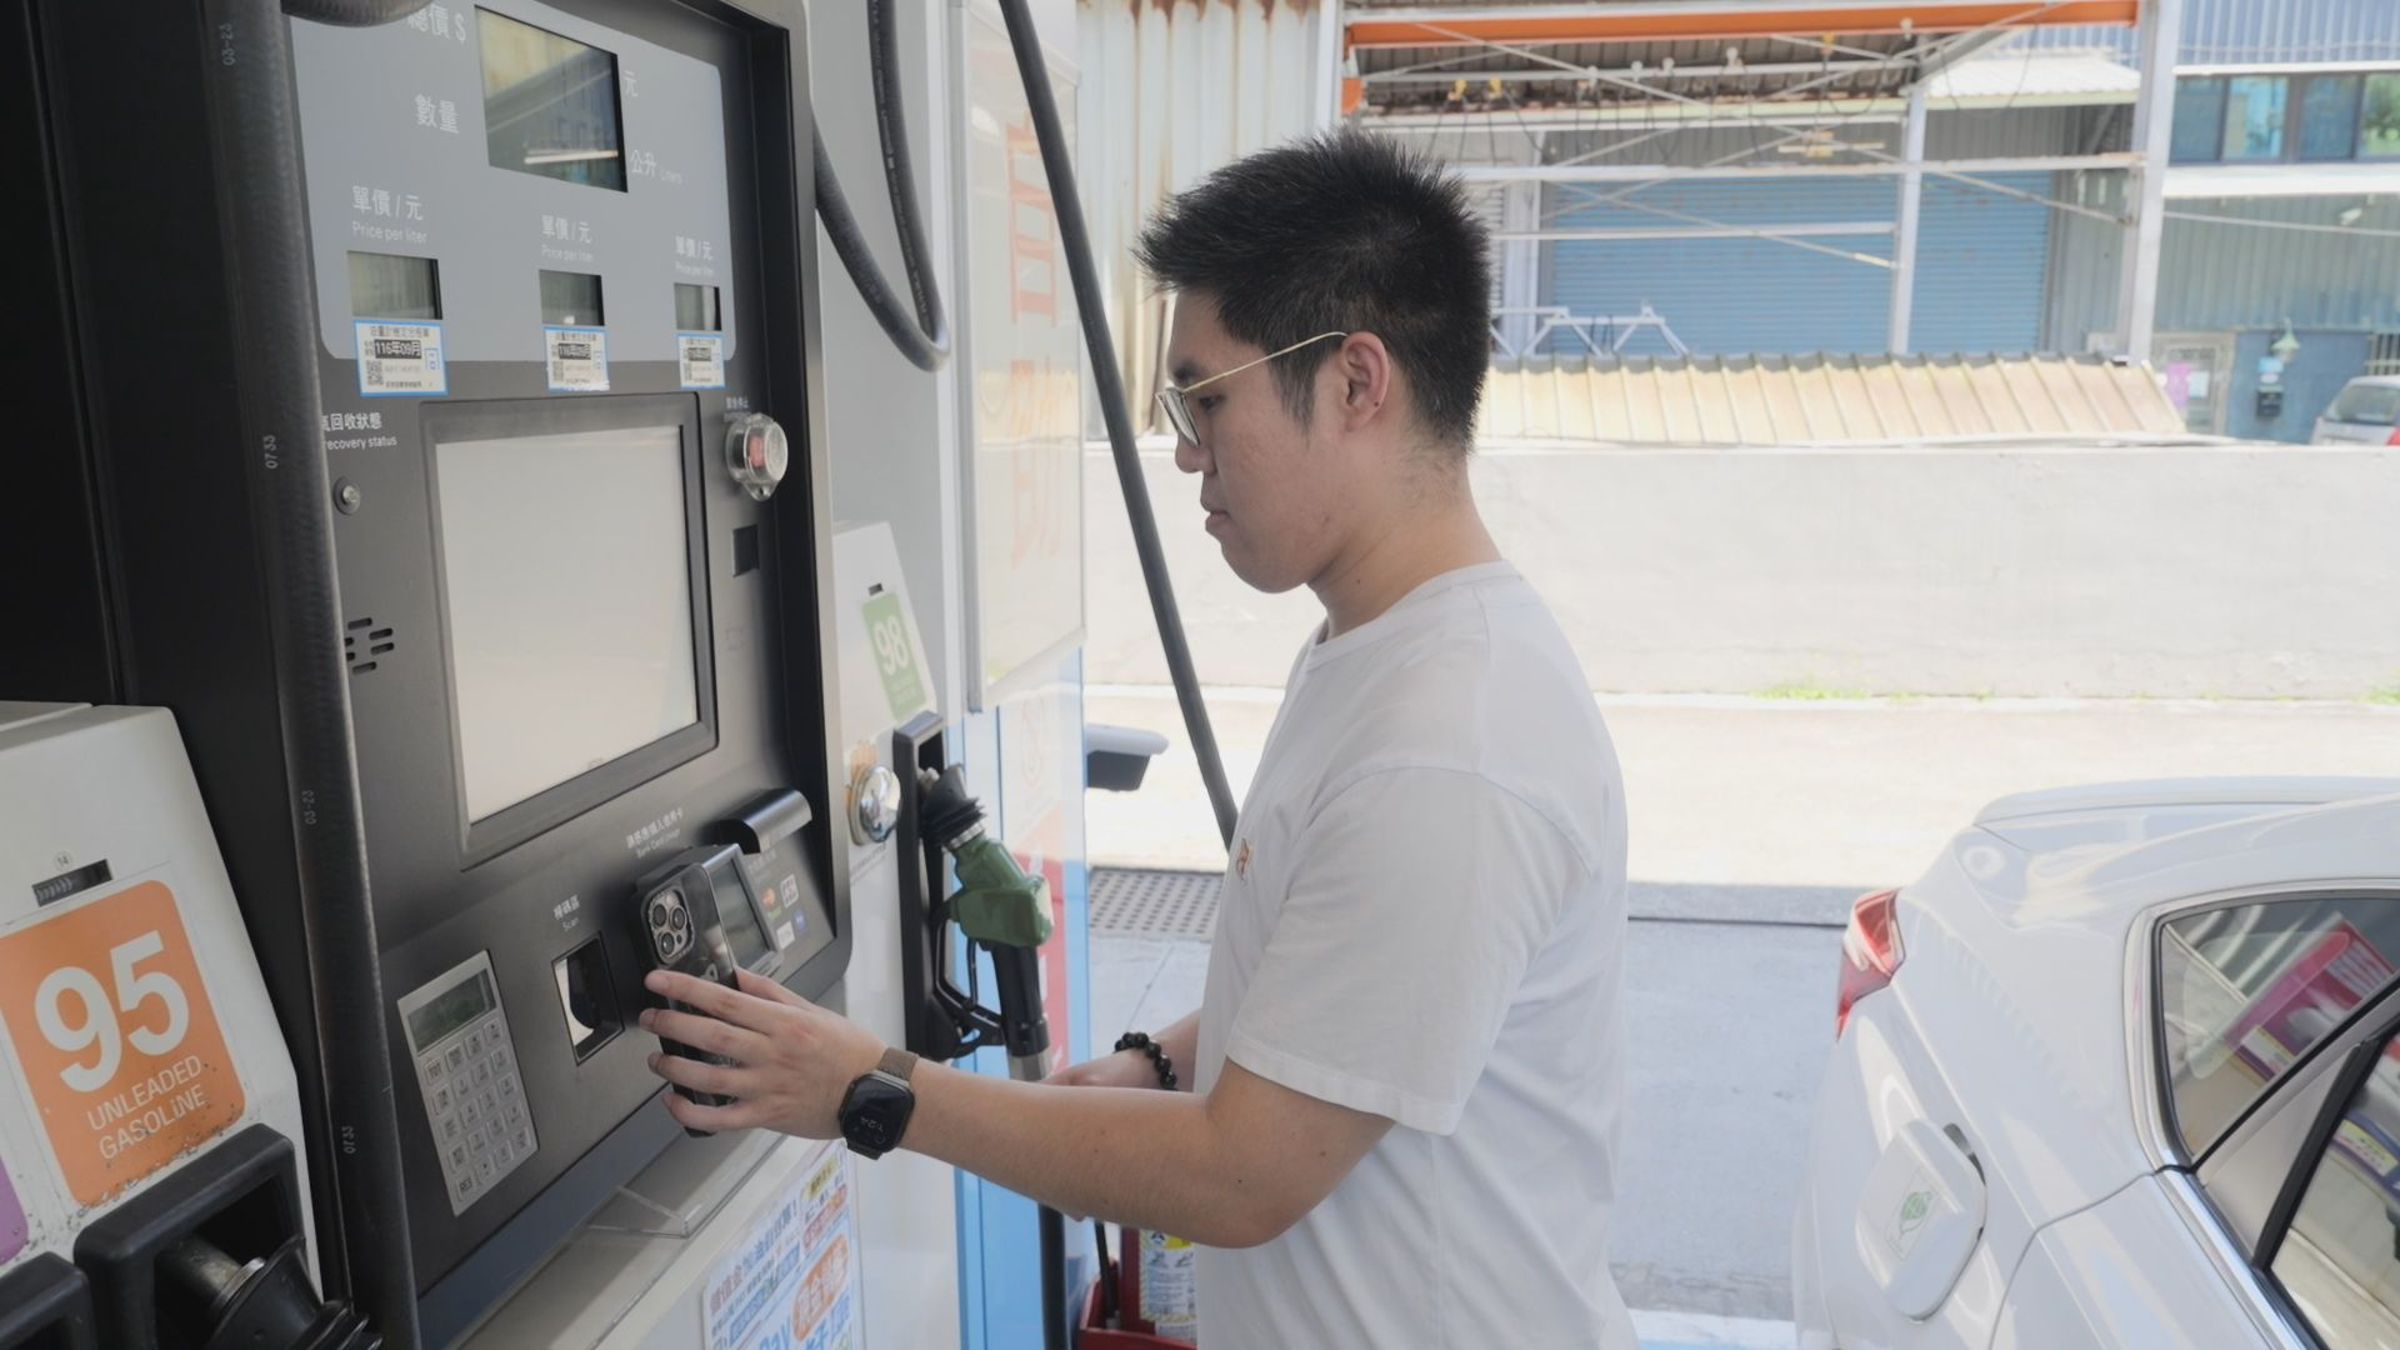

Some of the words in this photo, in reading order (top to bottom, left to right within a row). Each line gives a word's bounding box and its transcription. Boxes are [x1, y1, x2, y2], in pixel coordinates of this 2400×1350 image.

[623, 70, 639, 97] 元
[414, 94, 460, 134] 數量
[630, 149, 656, 178] 公升
[368, 435, 397, 448] status
[873, 615, 908, 676] 98
[34, 929, 190, 1093] 95
[87, 1054, 202, 1131] UNLEADED
[100, 1083, 206, 1160] GASOLINE
